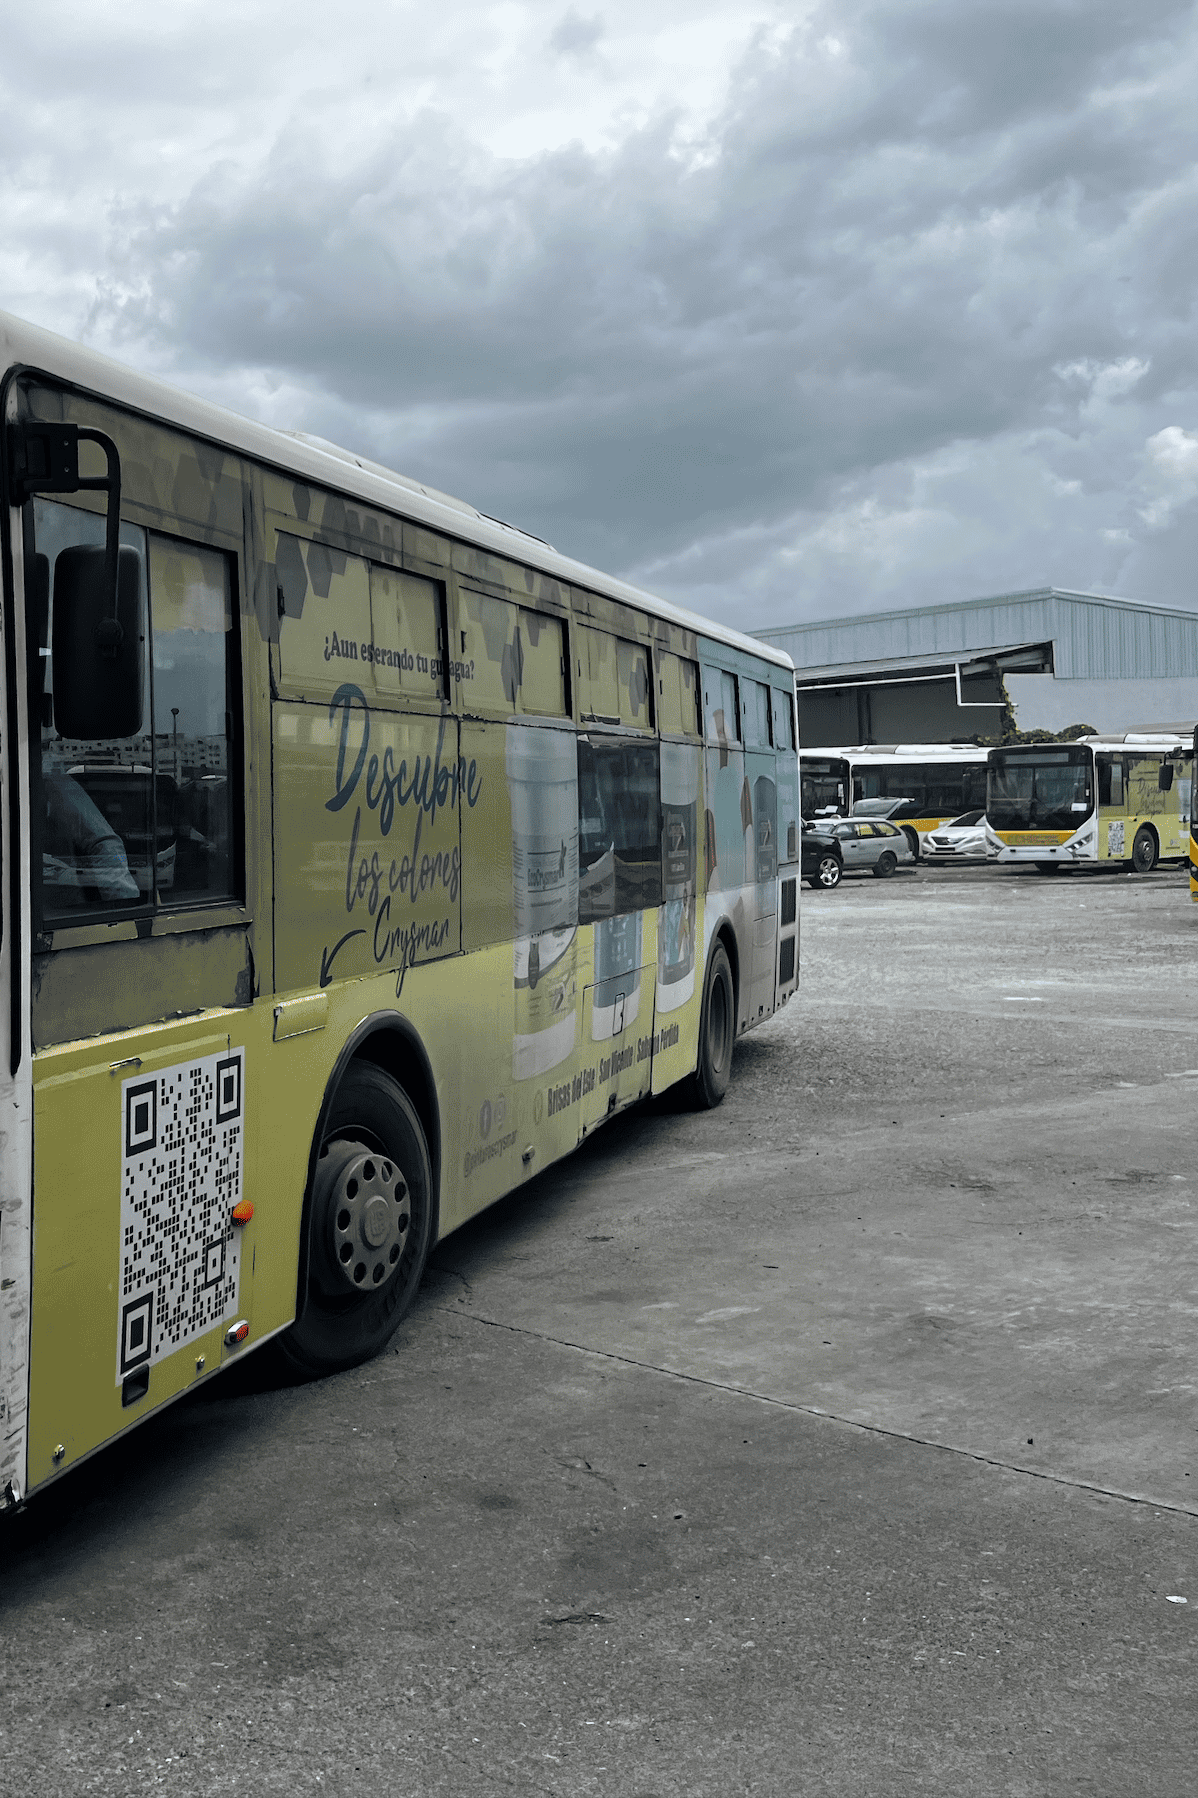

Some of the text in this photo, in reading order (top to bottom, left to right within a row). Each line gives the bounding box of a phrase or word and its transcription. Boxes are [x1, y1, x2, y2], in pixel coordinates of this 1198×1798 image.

[324, 631, 358, 661] ¿Aun
[416, 653, 428, 673] tu
[325, 683, 482, 836] Descubre
[389, 806, 462, 903] colores
[374, 896, 449, 998] Crysmar
